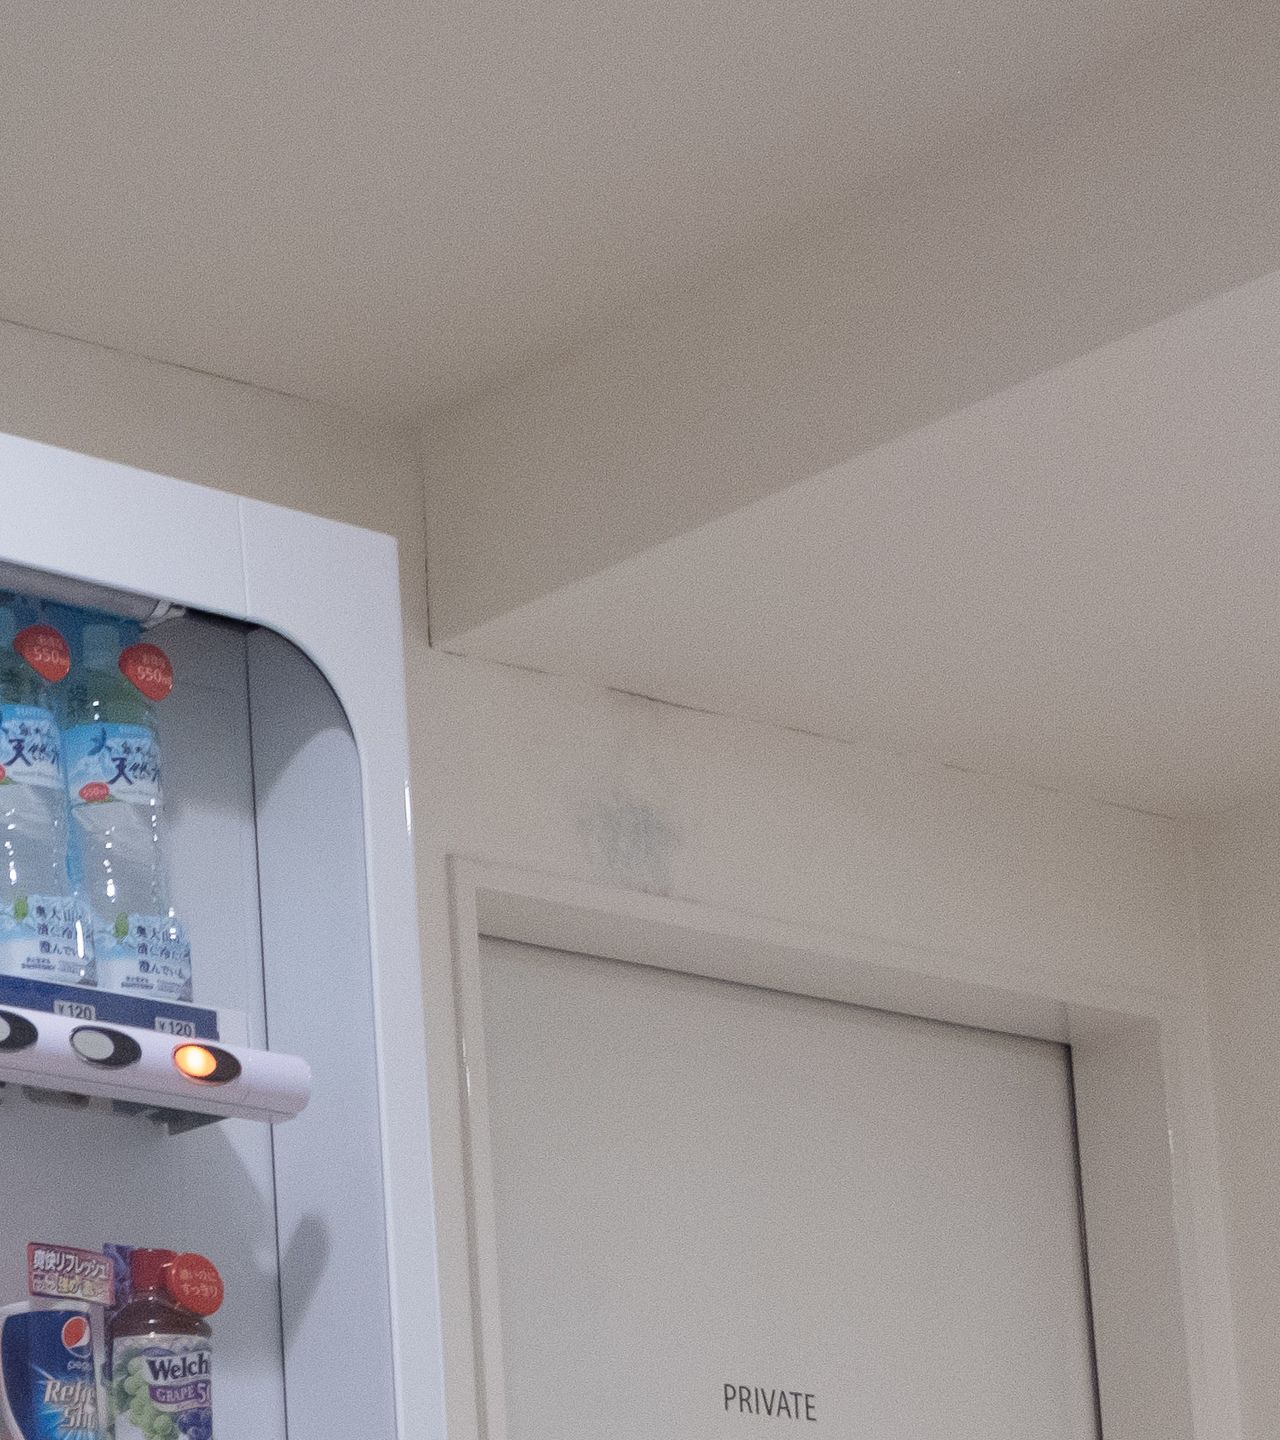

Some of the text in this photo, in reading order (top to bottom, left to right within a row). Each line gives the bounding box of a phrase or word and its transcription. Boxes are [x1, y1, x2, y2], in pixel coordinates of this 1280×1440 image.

[147, 1352, 211, 1382] Welch
[155, 1385, 196, 1403] GRAPE
[724, 1383, 817, 1421] PRIVATE
